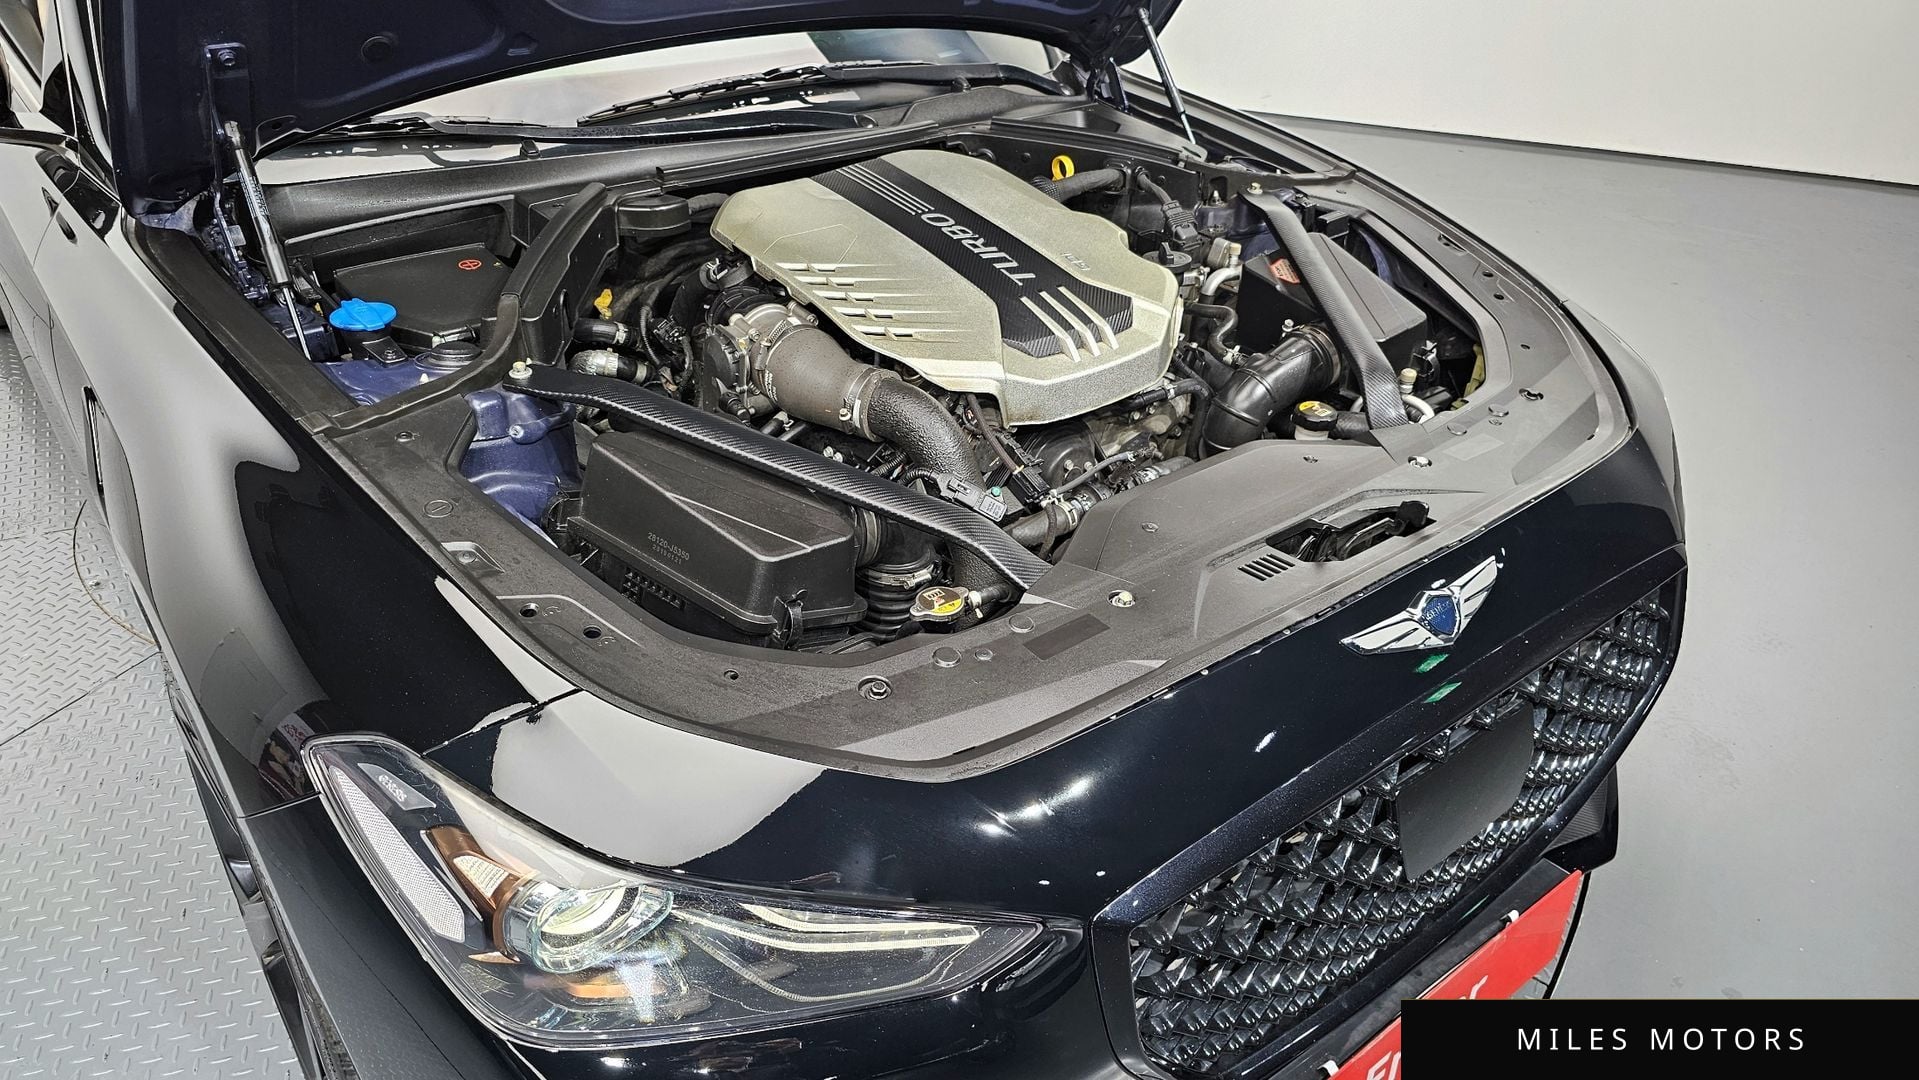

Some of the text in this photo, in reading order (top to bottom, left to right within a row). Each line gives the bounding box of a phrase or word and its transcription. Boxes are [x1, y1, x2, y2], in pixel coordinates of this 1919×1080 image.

[921, 213, 1036, 286] TURBO
[647, 532, 690, 561] 28120-J5350
[378, 774, 408, 802] GENESIS
